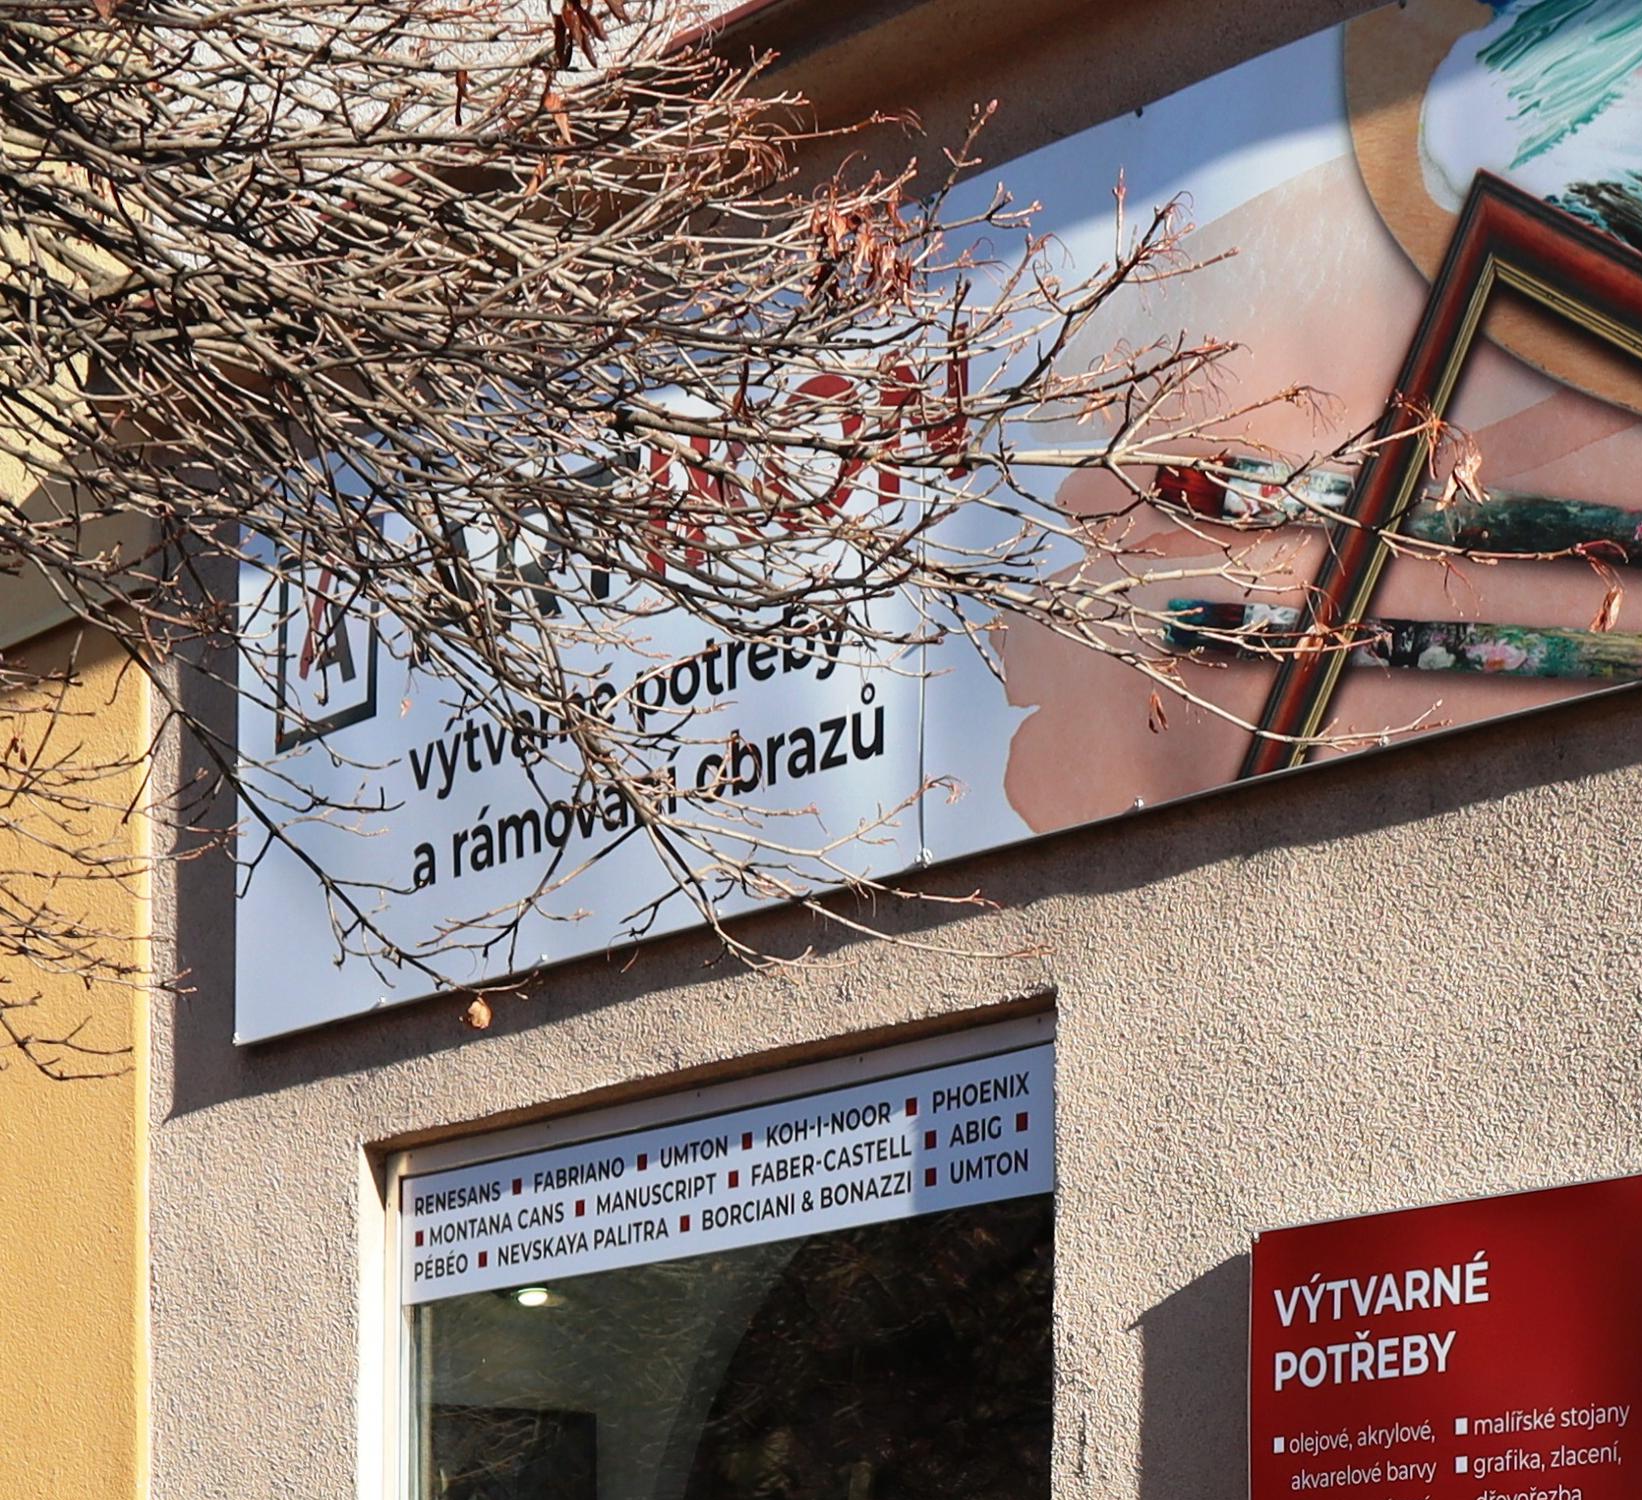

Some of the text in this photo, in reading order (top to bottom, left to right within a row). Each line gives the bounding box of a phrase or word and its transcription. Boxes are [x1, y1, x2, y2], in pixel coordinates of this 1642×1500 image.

[410, 322, 968, 668] RTIKON
[414, 842, 436, 886] a
[696, 684, 884, 796] obrazů
[414, 1071, 1030, 1217] RENESANS FABRIANO UMTON KOH-I-NOOR PHOENIX
[429, 1112, 1003, 1248] MONTANA CANS MANUSCRIPT FABER-CASTELL ABIG
[413, 1149, 1030, 1283] PÉBÉO NEVSKAYA PALITRA BORCIANI & BONAZZI UMTON
[1273, 1250, 1489, 1328] VÝTVARNÉ
[1274, 1330, 1456, 1391] POTŘEBY
[1289, 1419, 1436, 1457] olejové, akrylové,
[1473, 1402, 1631, 1437] malířské stojany
[1291, 1458, 1437, 1491] akvarelové barvy
[1473, 1440, 1622, 1479] grafika, zlacení,
